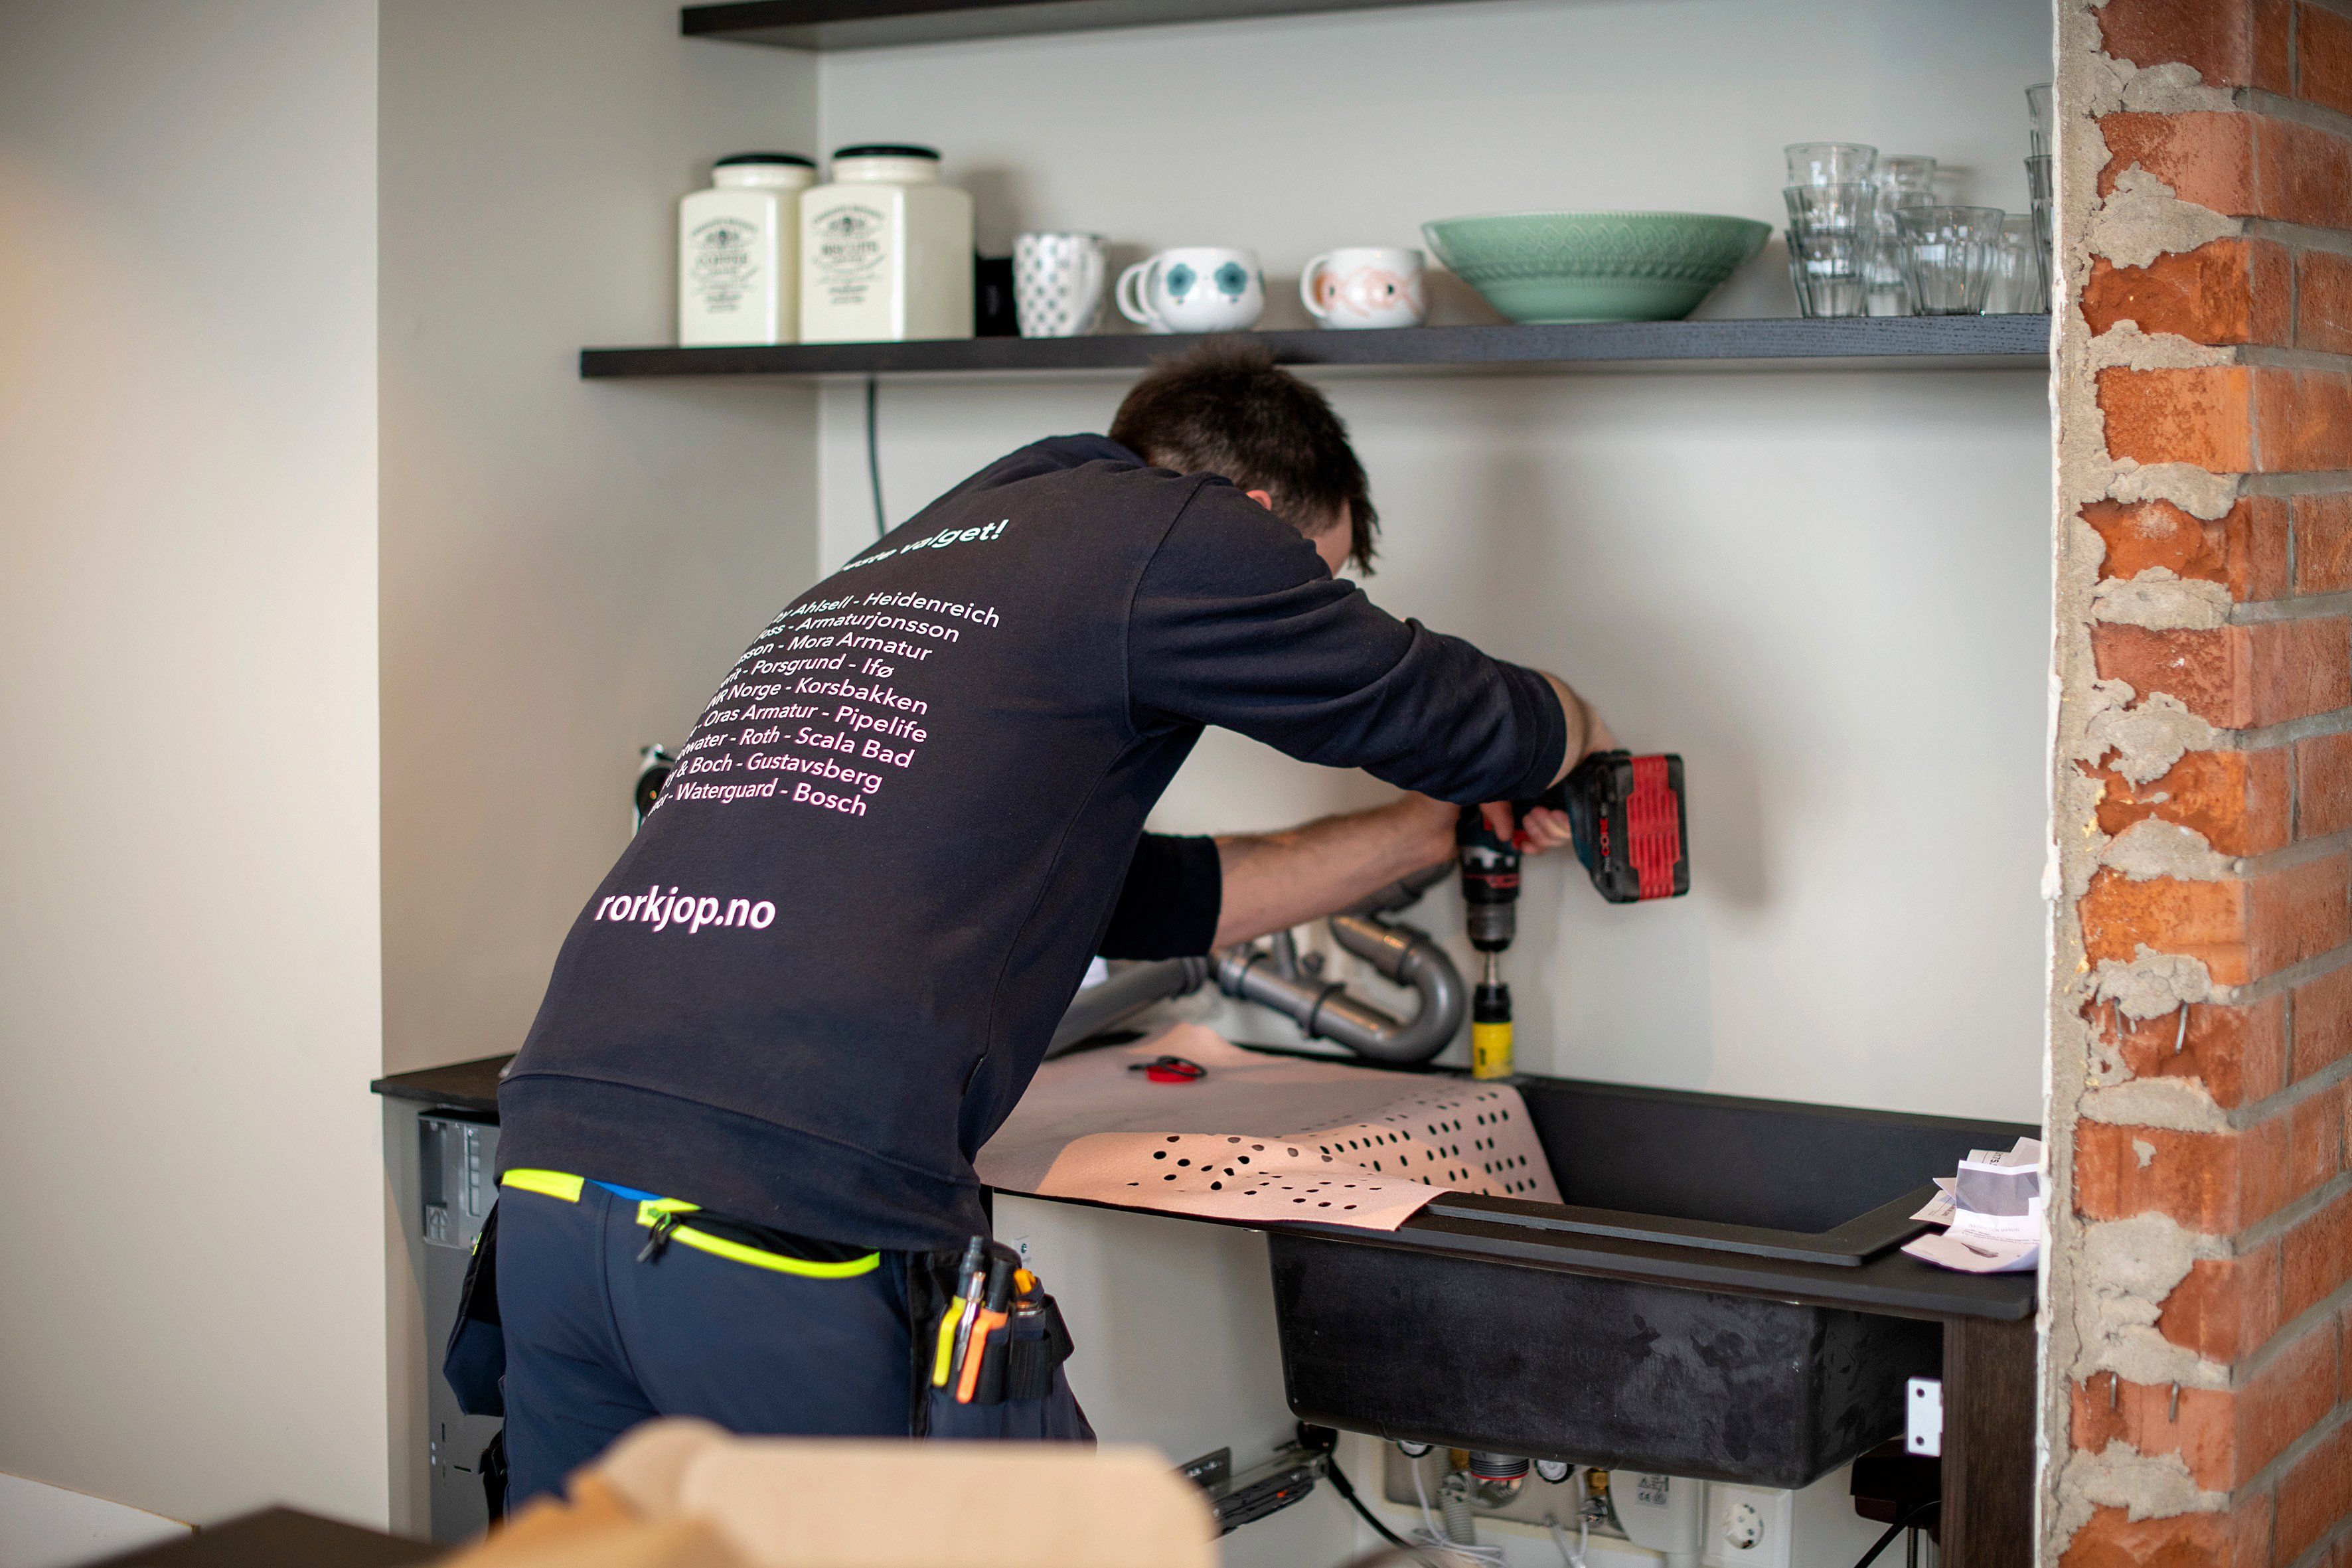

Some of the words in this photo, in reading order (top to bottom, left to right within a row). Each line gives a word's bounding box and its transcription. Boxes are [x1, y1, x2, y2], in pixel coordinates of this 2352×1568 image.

[900, 519, 1009, 555] valget!
[789, 595, 854, 617] Ahlsell
[862, 591, 1000, 628] Heidenreich
[795, 611, 960, 643] Armaturjonsson
[750, 653, 847, 676] Porsgrund
[861, 657, 895, 678] Ifø
[787, 635, 834, 651] Mora
[835, 631, 933, 661] Armatur
[727, 682, 782, 701] Norge
[795, 676, 928, 716] Korsbakken
[704, 708, 742, 728] Oras
[740, 703, 819, 722] Armatur
[834, 705, 927, 744] Pipelife
[739, 725, 781, 745] Roth
[795, 726, 855, 754] Scala
[862, 739, 915, 769] Bad
[676, 760, 688, 778] &
[688, 753, 733, 774] Boch
[747, 752, 883, 795] Gustavsberg
[676, 777, 779, 804] Waterguard
[793, 782, 867, 817] Bosch
[594, 885, 776, 933] rorkjop.no
